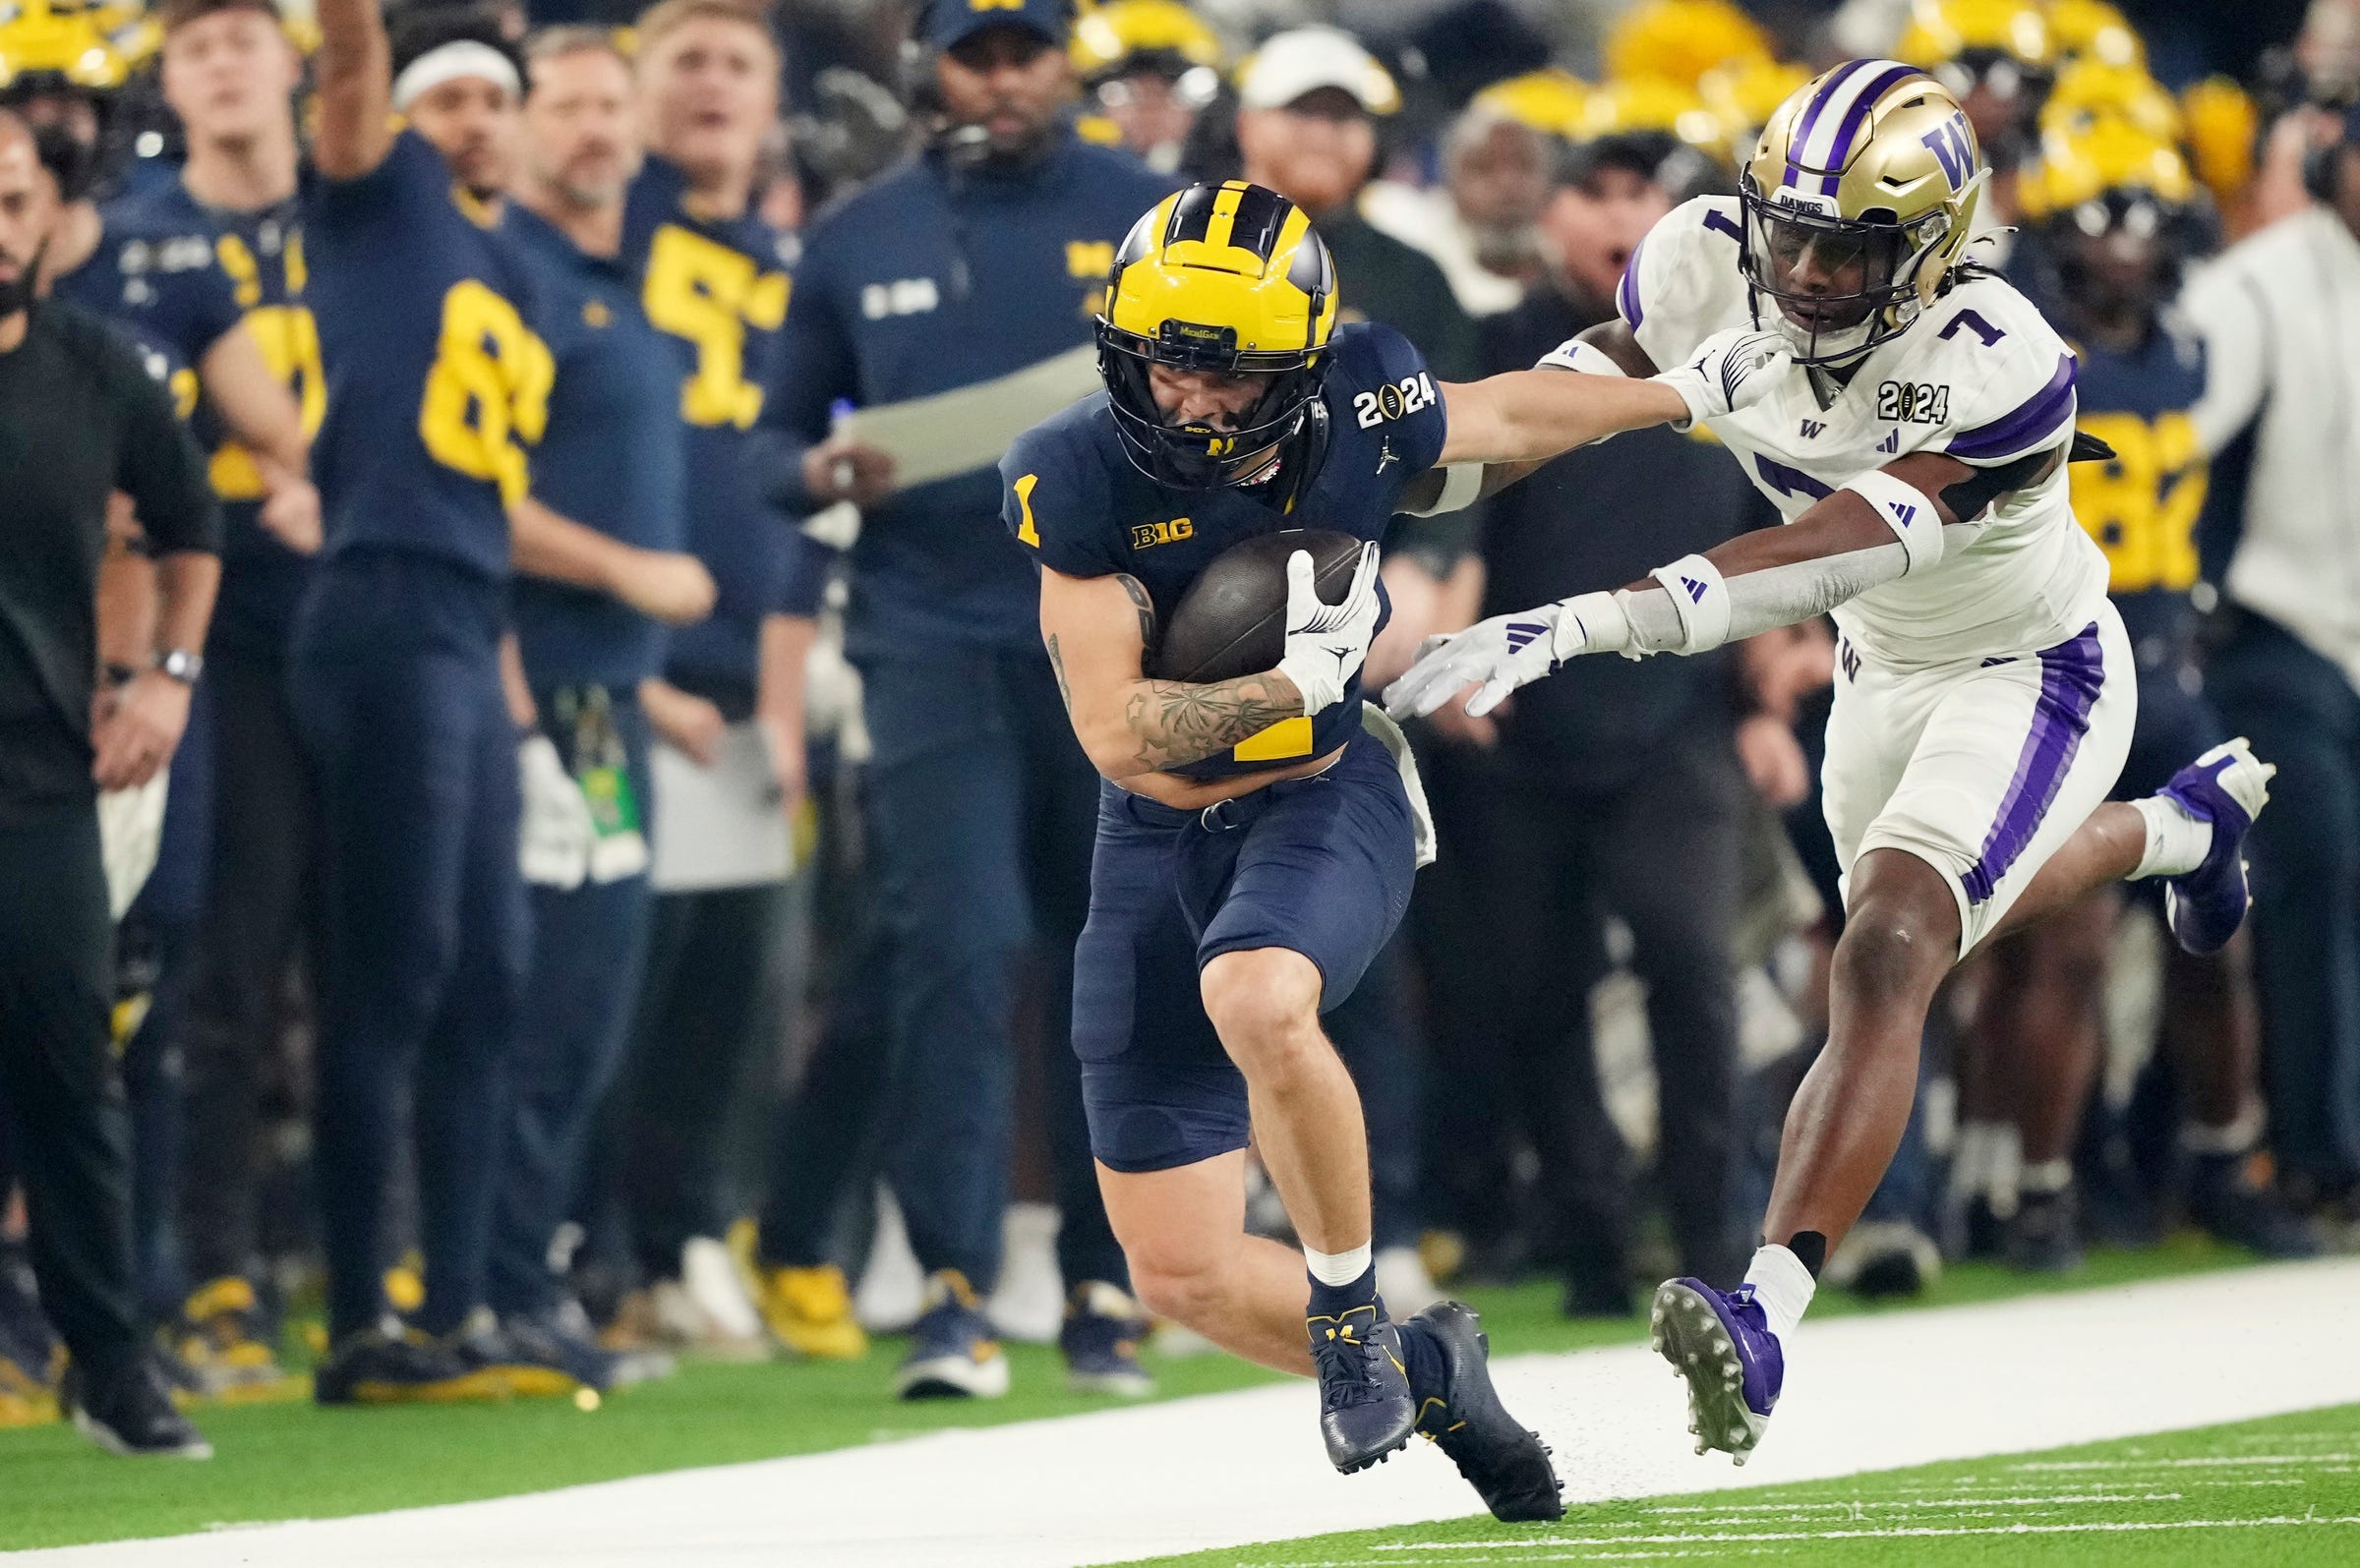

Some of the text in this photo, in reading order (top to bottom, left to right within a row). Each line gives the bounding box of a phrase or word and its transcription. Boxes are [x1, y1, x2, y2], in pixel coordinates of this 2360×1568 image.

[1920, 111, 1977, 195] W
[1780, 195, 1823, 213] DAWGS
[1937, 308, 2007, 347] 7
[1877, 380, 1950, 425] 2024
[1800, 419, 1827, 439] W
[1013, 474, 1040, 549] 1
[1842, 635, 1862, 684] W
